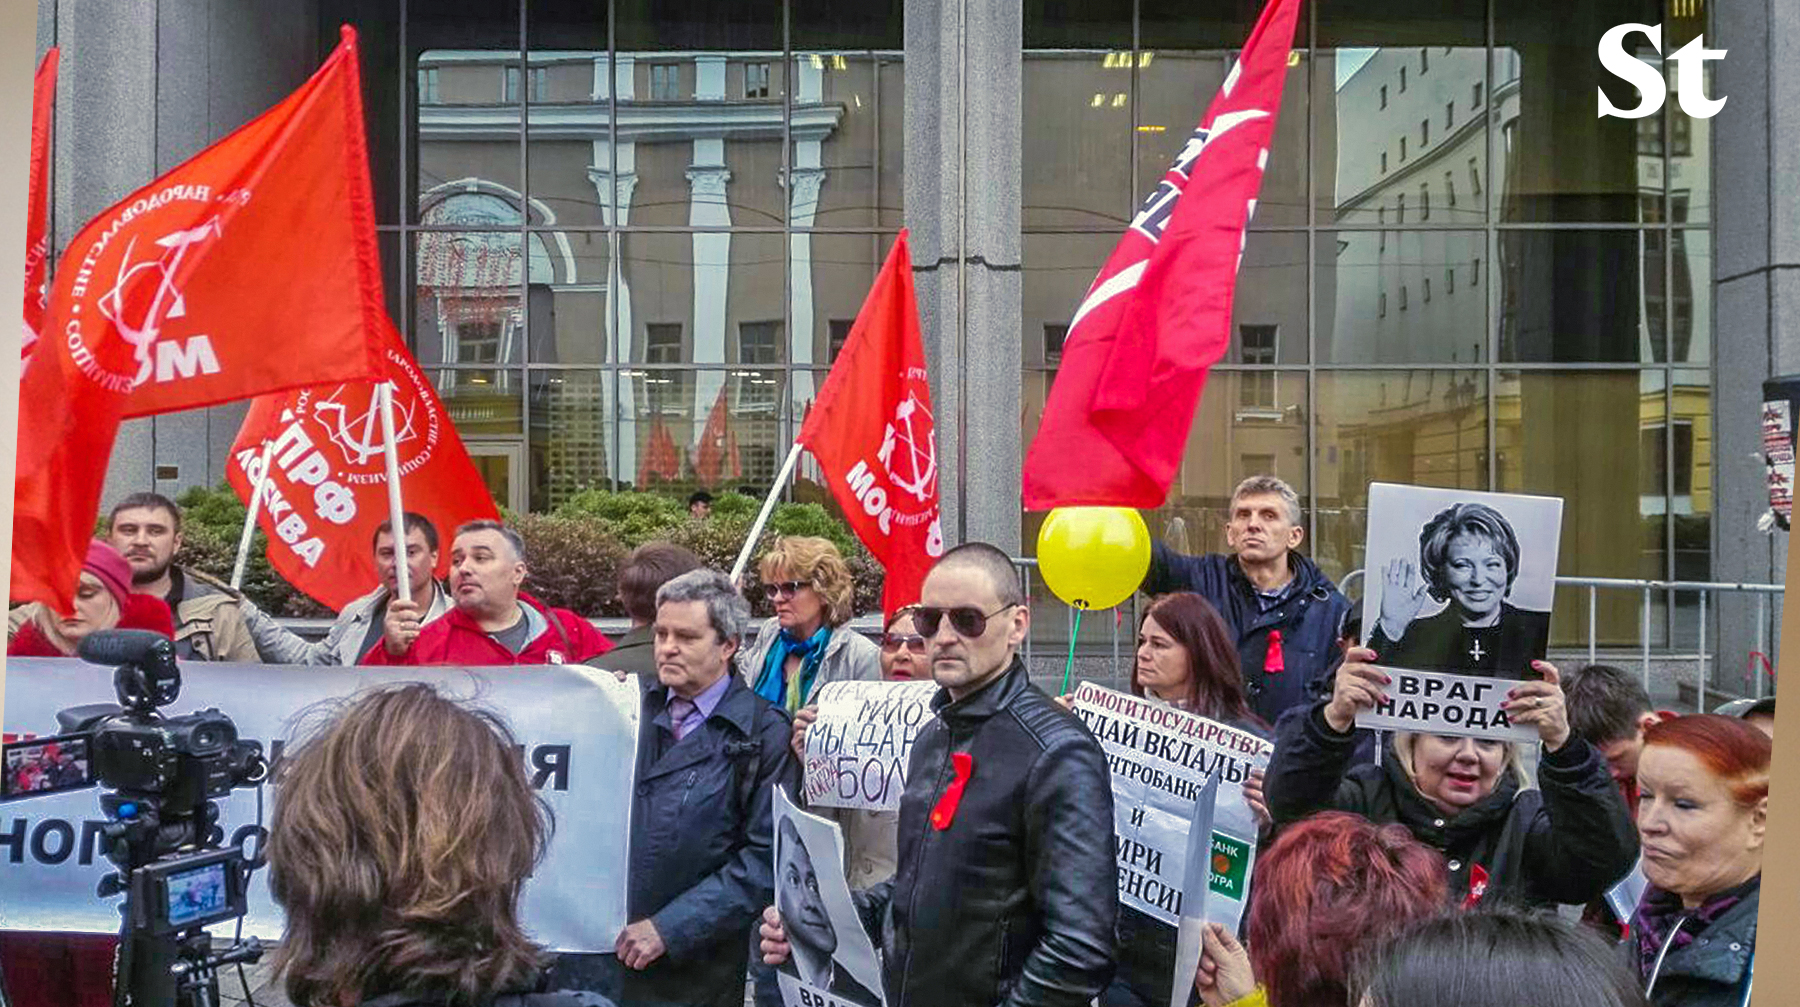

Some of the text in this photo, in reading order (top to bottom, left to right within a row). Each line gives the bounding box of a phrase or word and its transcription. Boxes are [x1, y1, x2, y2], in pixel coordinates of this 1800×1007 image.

[270, 408, 357, 525] ПРФ
[1399, 675, 1493, 702] ВРАГ
[1376, 698, 1511, 730] НАРОДА
[853, 723, 919, 757] ДАН
[1143, 730, 1252, 785] ВКЛАДЫ
[838, 757, 907, 805] БОЛ
[1104, 752, 1202, 802] НТРОБАНК
[1130, 807, 1145, 827] И
